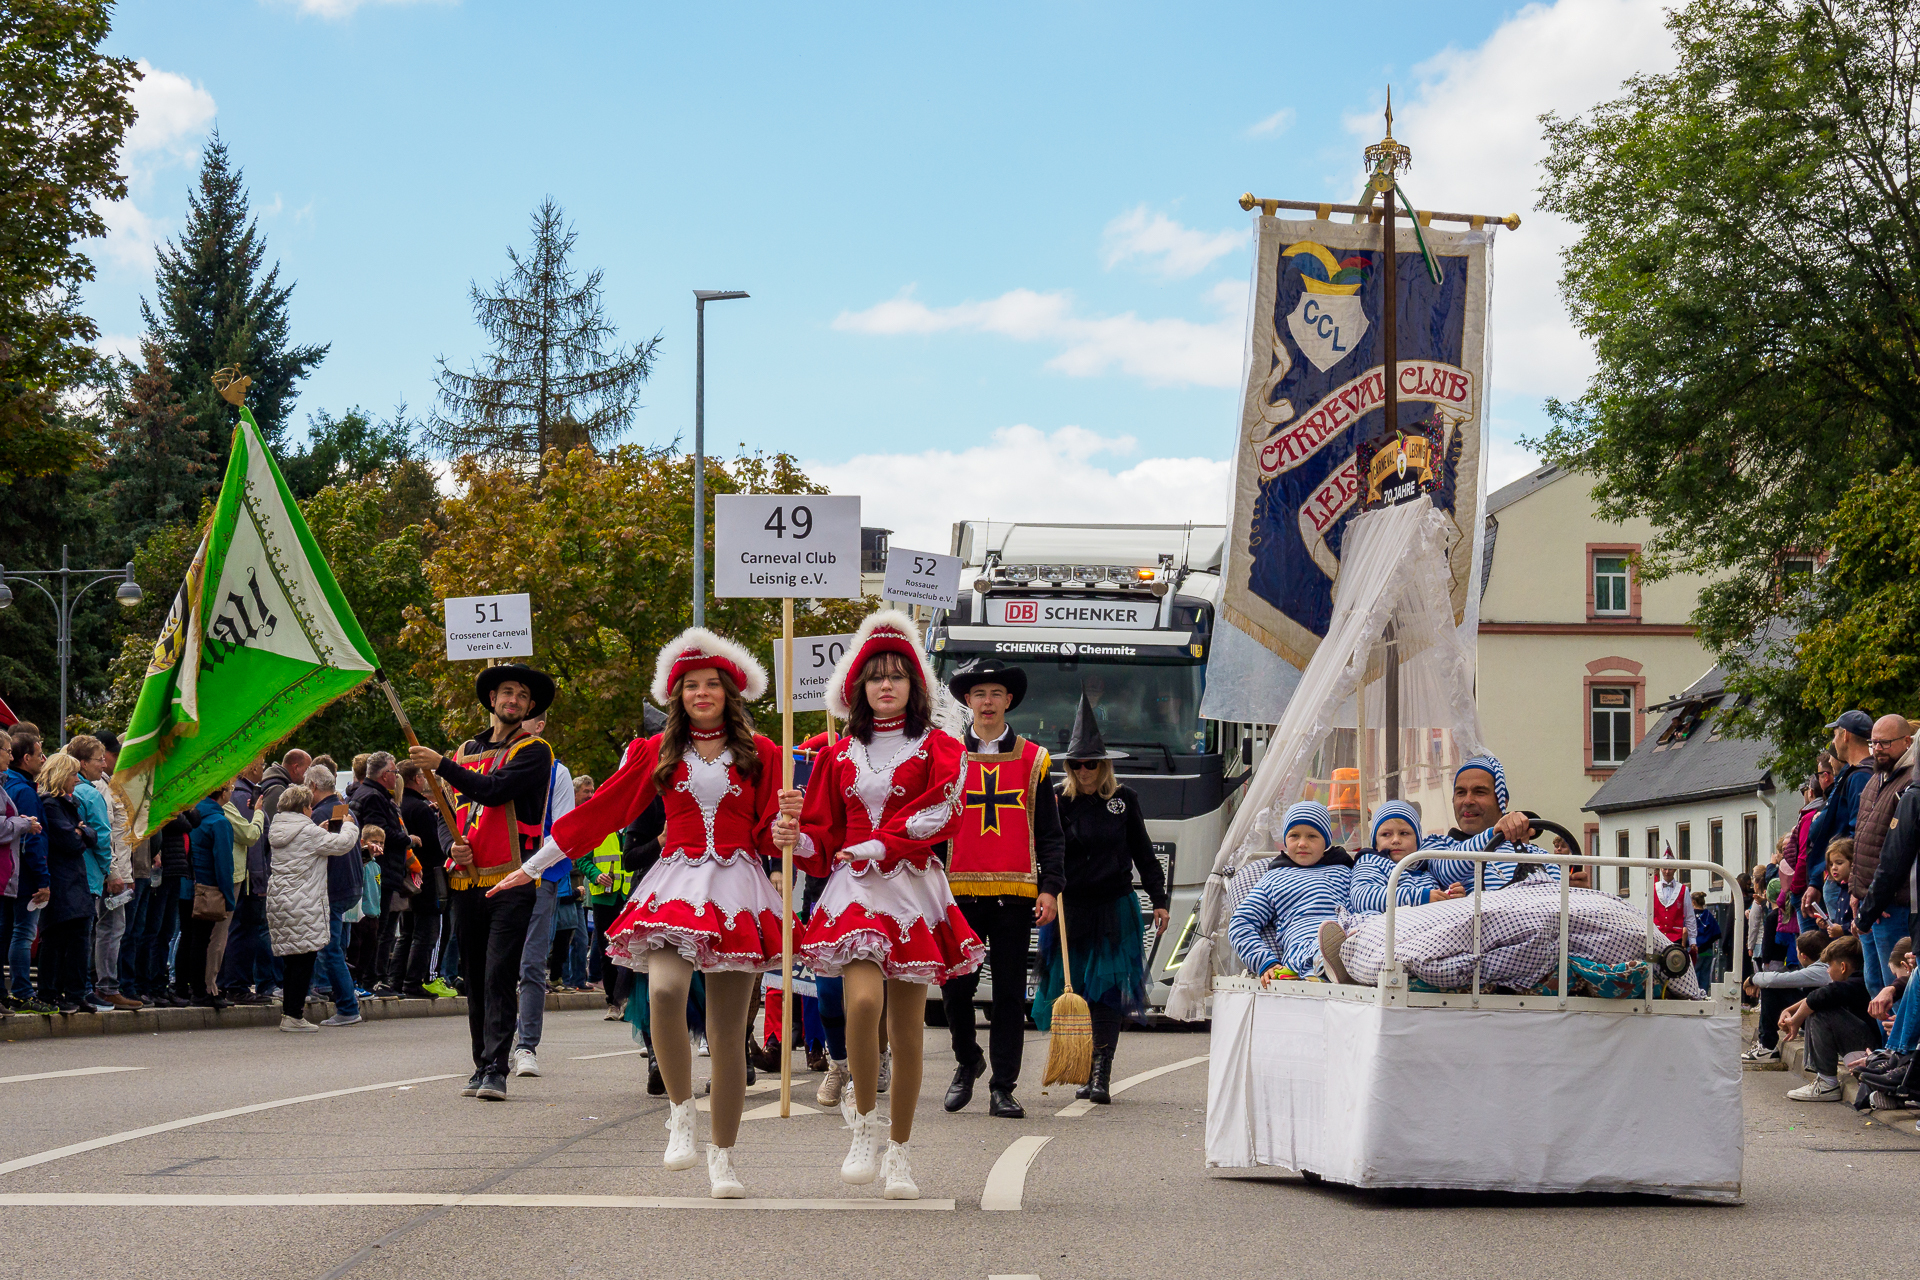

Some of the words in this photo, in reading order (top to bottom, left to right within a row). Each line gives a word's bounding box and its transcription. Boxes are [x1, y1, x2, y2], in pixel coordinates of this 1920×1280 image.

[1303, 299, 1347, 352] CCL
[1260, 372, 1386, 472] CARNEVAL
[1399, 366, 1468, 402] CLUB
[1373, 449, 1395, 480] CARNEVAL
[1394, 480, 1416, 501] JAHRE
[764, 505, 813, 539] 49
[740, 552, 802, 564] Carneval
[805, 551, 837, 564] Club
[912, 556, 937, 577] 52
[749, 572, 797, 587] Leisnig
[801, 573, 828, 585] e.V.
[905, 579, 939, 590] Rossauer
[887, 587, 938, 600] Karnevalsclub
[938, 595, 954, 603] e.V.
[475, 602, 504, 624] 51
[1008, 604, 1034, 620] DB
[1044, 606, 1138, 623] SCHENKER
[449, 631, 490, 641] Crossener
[492, 627, 528, 638] Carneval
[466, 642, 494, 652] Verein
[495, 641, 512, 650] e.V.
[811, 642, 845, 668] 50
[995, 642, 1059, 654] SCHENKER
[1078, 644, 1136, 656] Chemnitz
[792, 690, 825, 700] aschin
